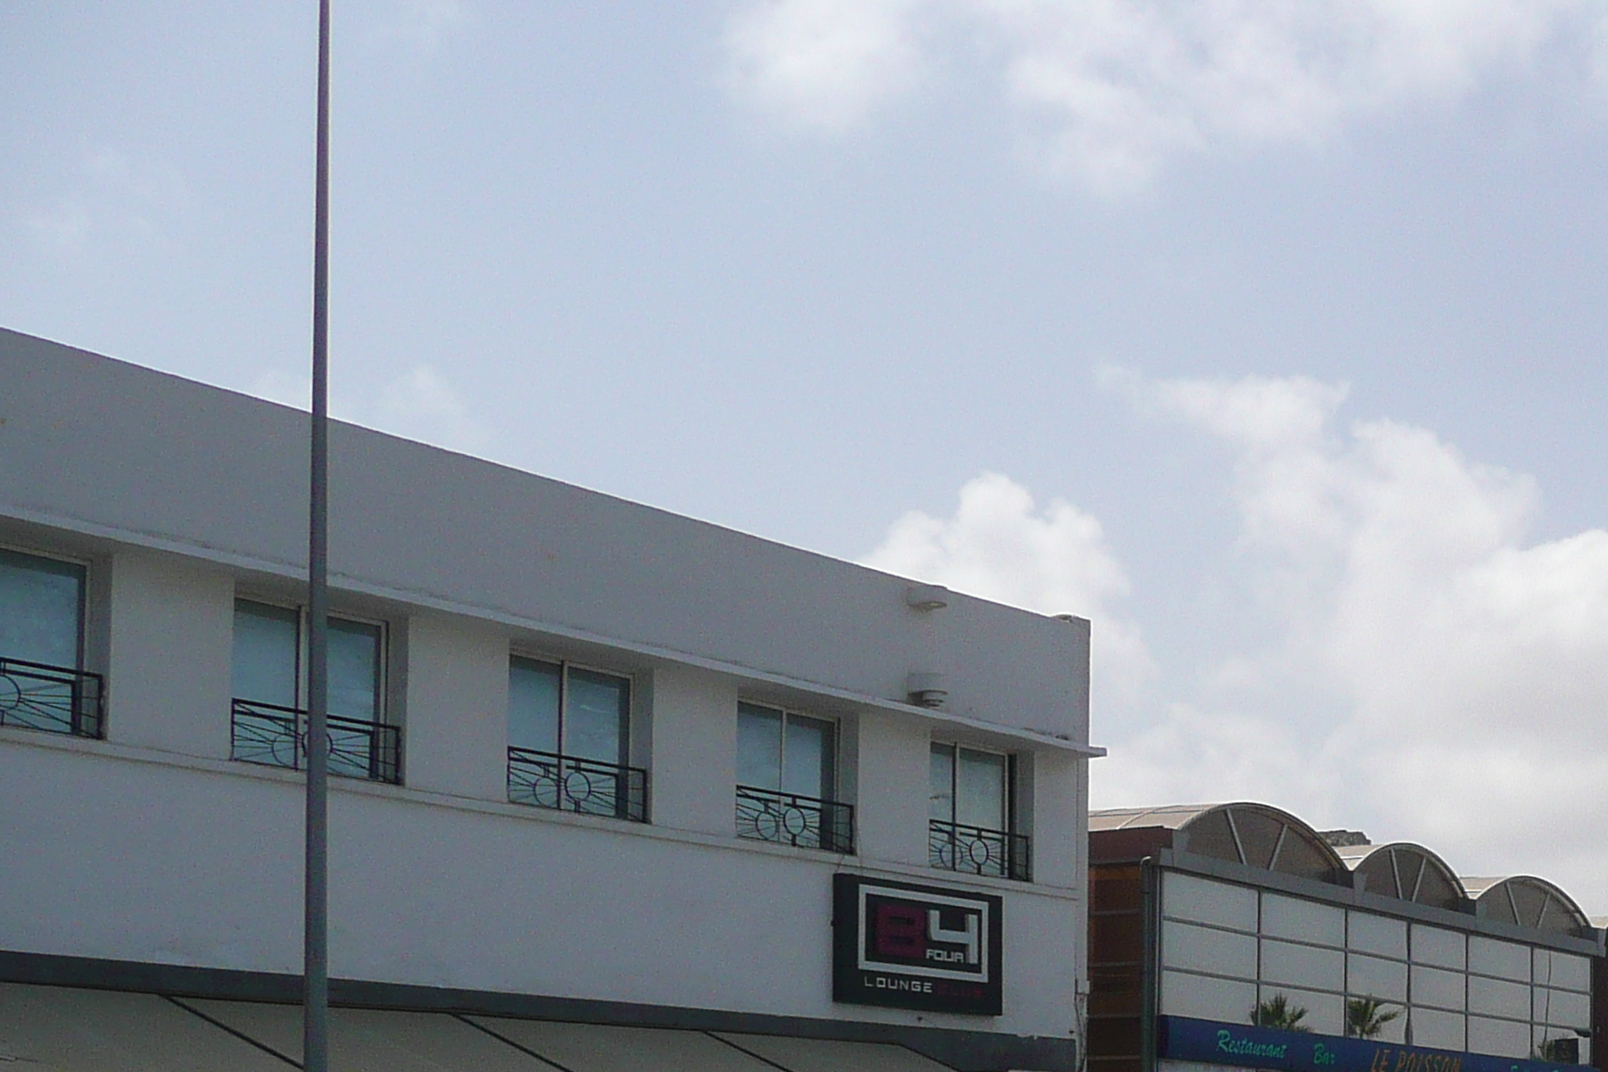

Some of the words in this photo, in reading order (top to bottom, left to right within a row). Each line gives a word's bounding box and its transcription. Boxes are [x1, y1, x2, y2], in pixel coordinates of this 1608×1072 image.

[925, 948, 965, 964] FOUR
[864, 975, 933, 993] LOUNGE
[1215, 1029, 1288, 1059] Restaurant
[1313, 1041, 1336, 1066] Bar
